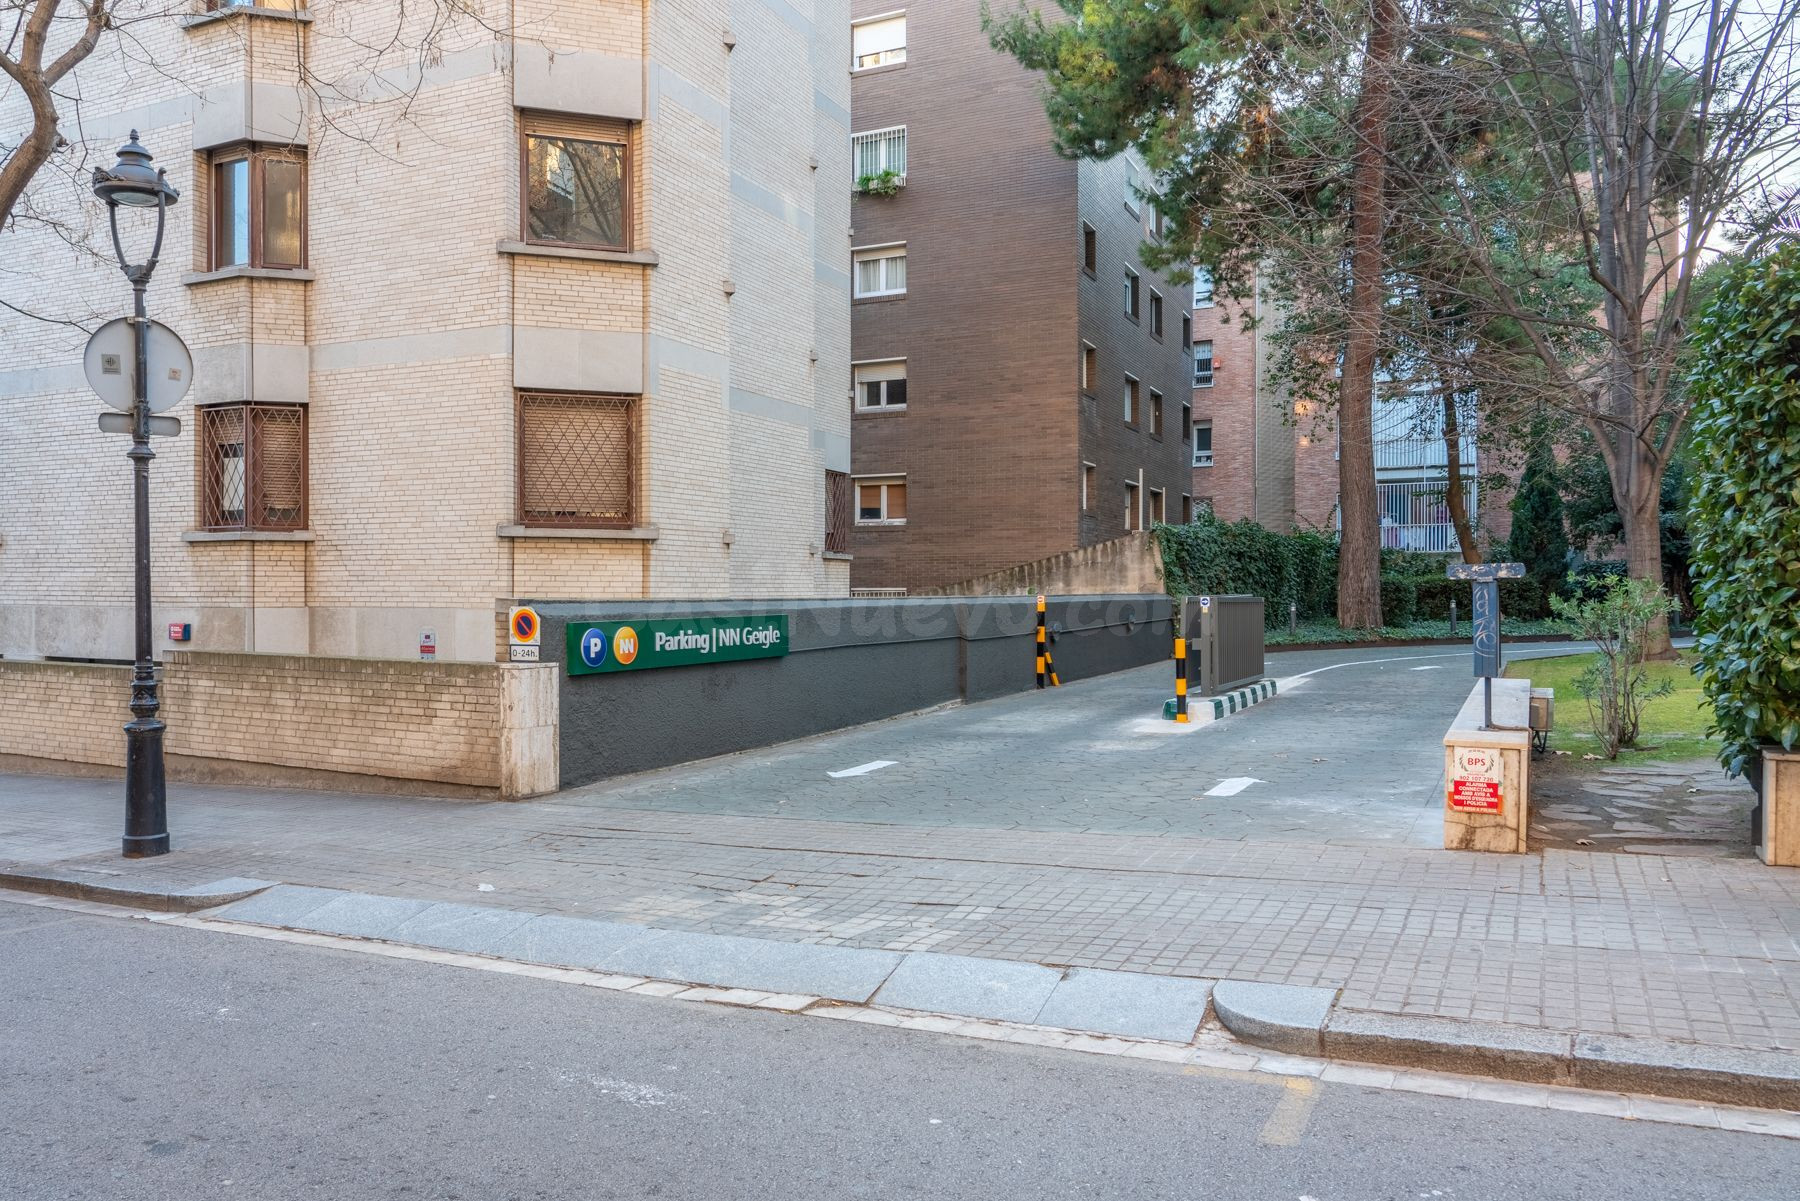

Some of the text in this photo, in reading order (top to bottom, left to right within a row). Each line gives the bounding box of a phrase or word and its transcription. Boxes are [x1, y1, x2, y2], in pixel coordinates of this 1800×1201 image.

[590, 638, 601, 658] P
[655, 630, 710, 654] Parking
[719, 628, 740, 647] NN
[742, 625, 781, 649] Geigle
[1467, 757, 1486, 766] BPS
